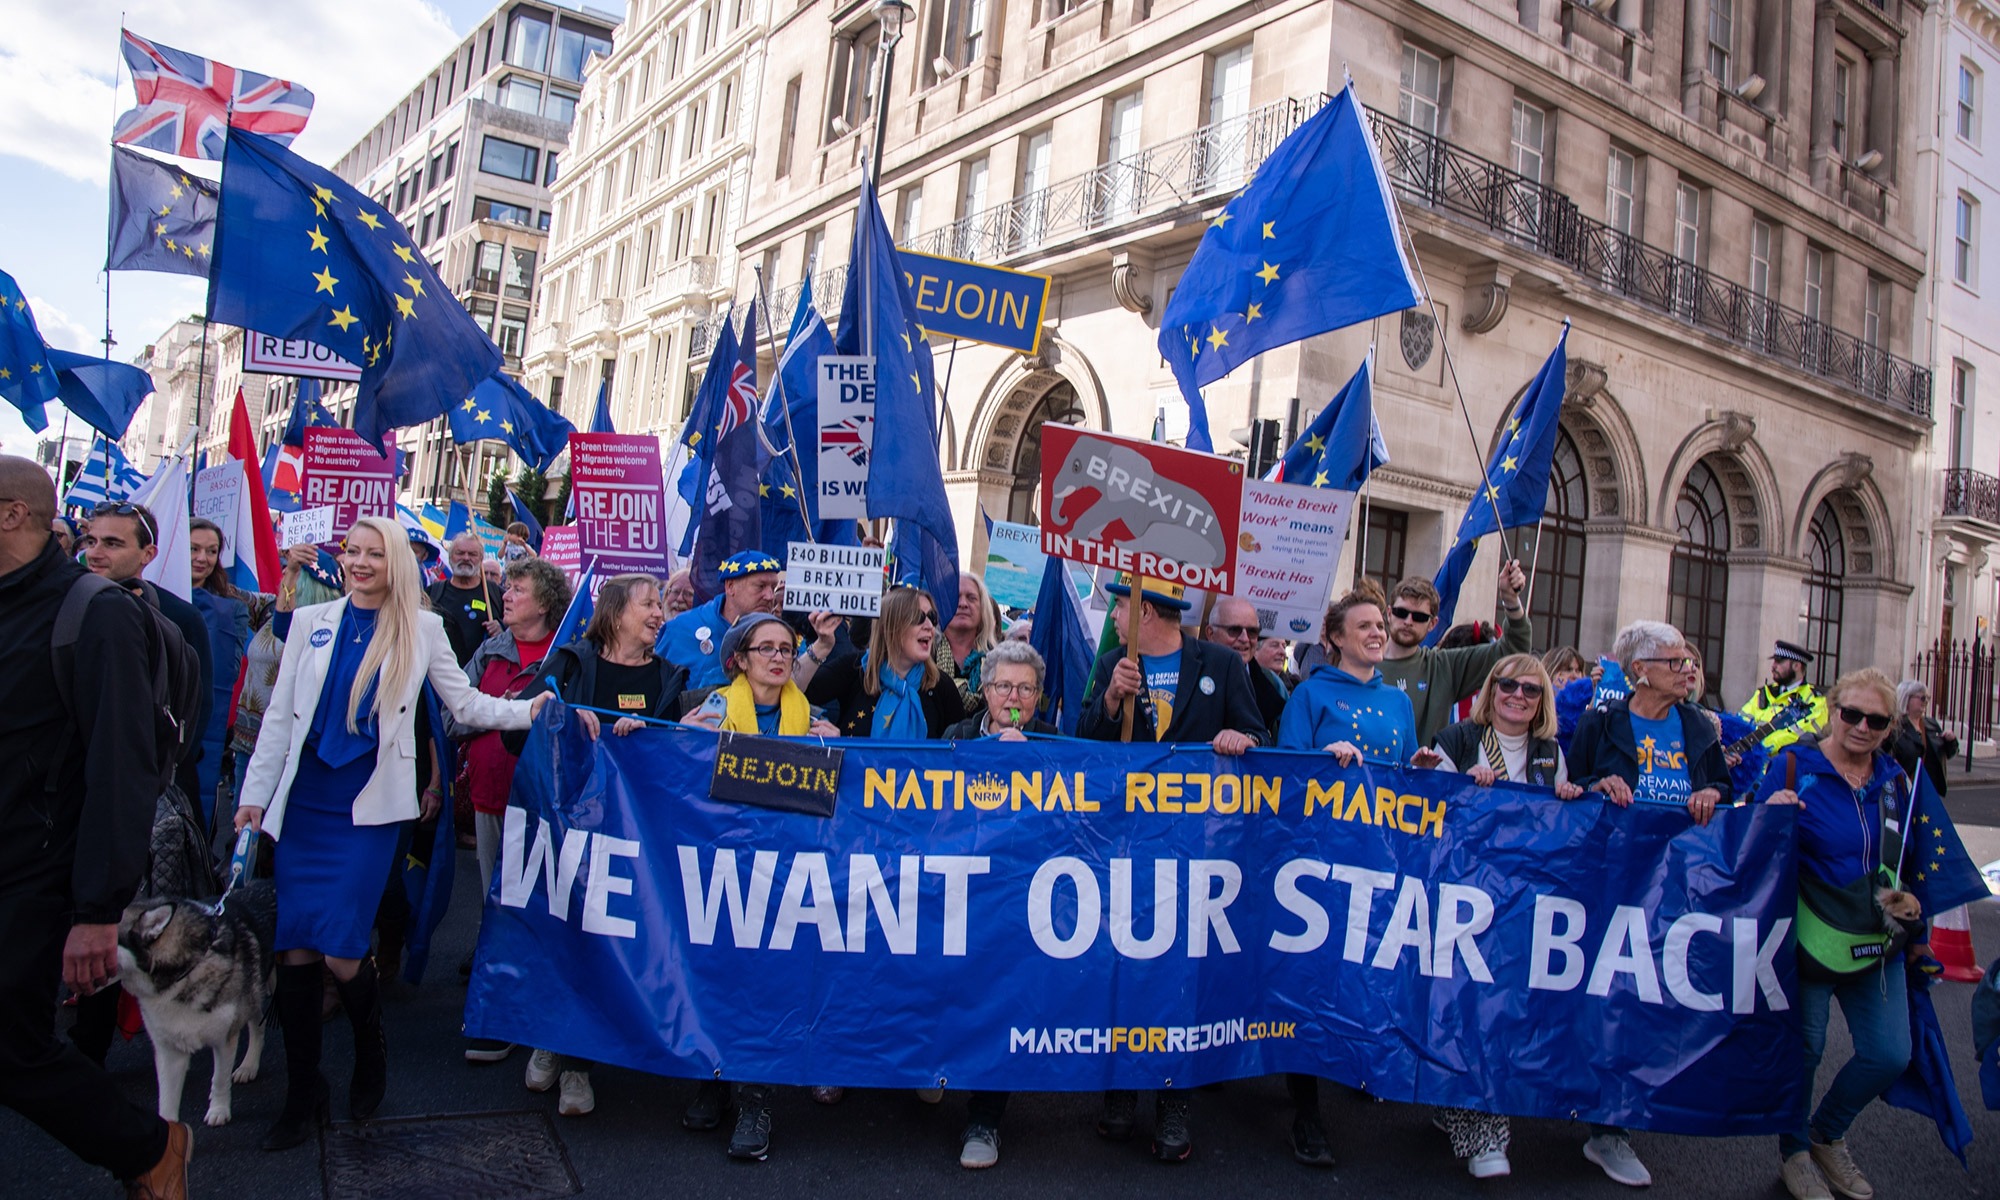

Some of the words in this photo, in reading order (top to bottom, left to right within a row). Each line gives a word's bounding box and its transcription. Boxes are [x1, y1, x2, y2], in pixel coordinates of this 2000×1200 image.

[262, 336, 350, 363] REJO
[824, 363, 868, 381] THE
[316, 434, 337, 444] Green
[338, 436, 371, 446] transiti
[581, 441, 601, 452] Green
[602, 443, 638, 453] transition
[639, 446, 655, 454] now
[315, 445, 348, 456] Migrants
[349, 448, 381, 457] welcom
[315, 456, 324, 464] No
[325, 457, 360, 467] austerity
[582, 454, 613, 465] Migrants
[614, 455, 647, 465] welcome
[200, 467, 225, 483] BREXIT
[582, 466, 591, 475] No
[592, 467, 626, 478] austerity
[210, 477, 237, 492] BASICS
[307, 477, 390, 505] REJOIN
[822, 480, 840, 496] IS
[1086, 455, 1214, 536] BREXIT!
[579, 491, 657, 522] REJOIN
[1297, 498, 1338, 514] Brexit
[292, 510, 324, 524] RESET
[288, 520, 325, 535] REPAIR
[581, 519, 621, 548] THE
[628, 522, 659, 550] EU
[1290, 520, 1334, 535] means
[555, 532, 575, 541] Green
[996, 527, 1040, 545] BREXIT
[1305, 538, 1328, 547] person
[550, 553, 560, 561] No
[790, 547, 816, 562] £40
[820, 549, 883, 567] BILLION
[1272, 545, 1293, 553] saying
[1307, 548, 1328, 557] knows
[601, 562, 620, 570] Another
[621, 564, 638, 573] Europe
[1046, 532, 1073, 558] IN
[1078, 539, 1134, 571] THE
[1139, 552, 1228, 592] ROOM
[1291, 557, 1304, 565] that
[804, 570, 864, 588] BREXIT
[1288, 571, 1314, 585] Has
[786, 591, 830, 608] BLACK
[840, 595, 878, 612] HOLE
[1599, 687, 1624, 700] YOU
[717, 752, 837, 794] REJOIN
[1638, 774, 1692, 791] REMAIN
[974, 791, 1002, 802] NRM
[1125, 772, 1282, 816] REJOIN
[1304, 778, 1447, 838] MARCH
[500, 805, 641, 939] WE
[677, 845, 990, 956] WANT
[1027, 855, 1243, 960] OUR
[1268, 858, 1494, 984] STAR
[1528, 894, 1793, 1015] BACK
[1861, 945, 1871, 956] NOT
[1010, 1017, 1296, 1053] MARCHFORREJOIN.CO.UK
